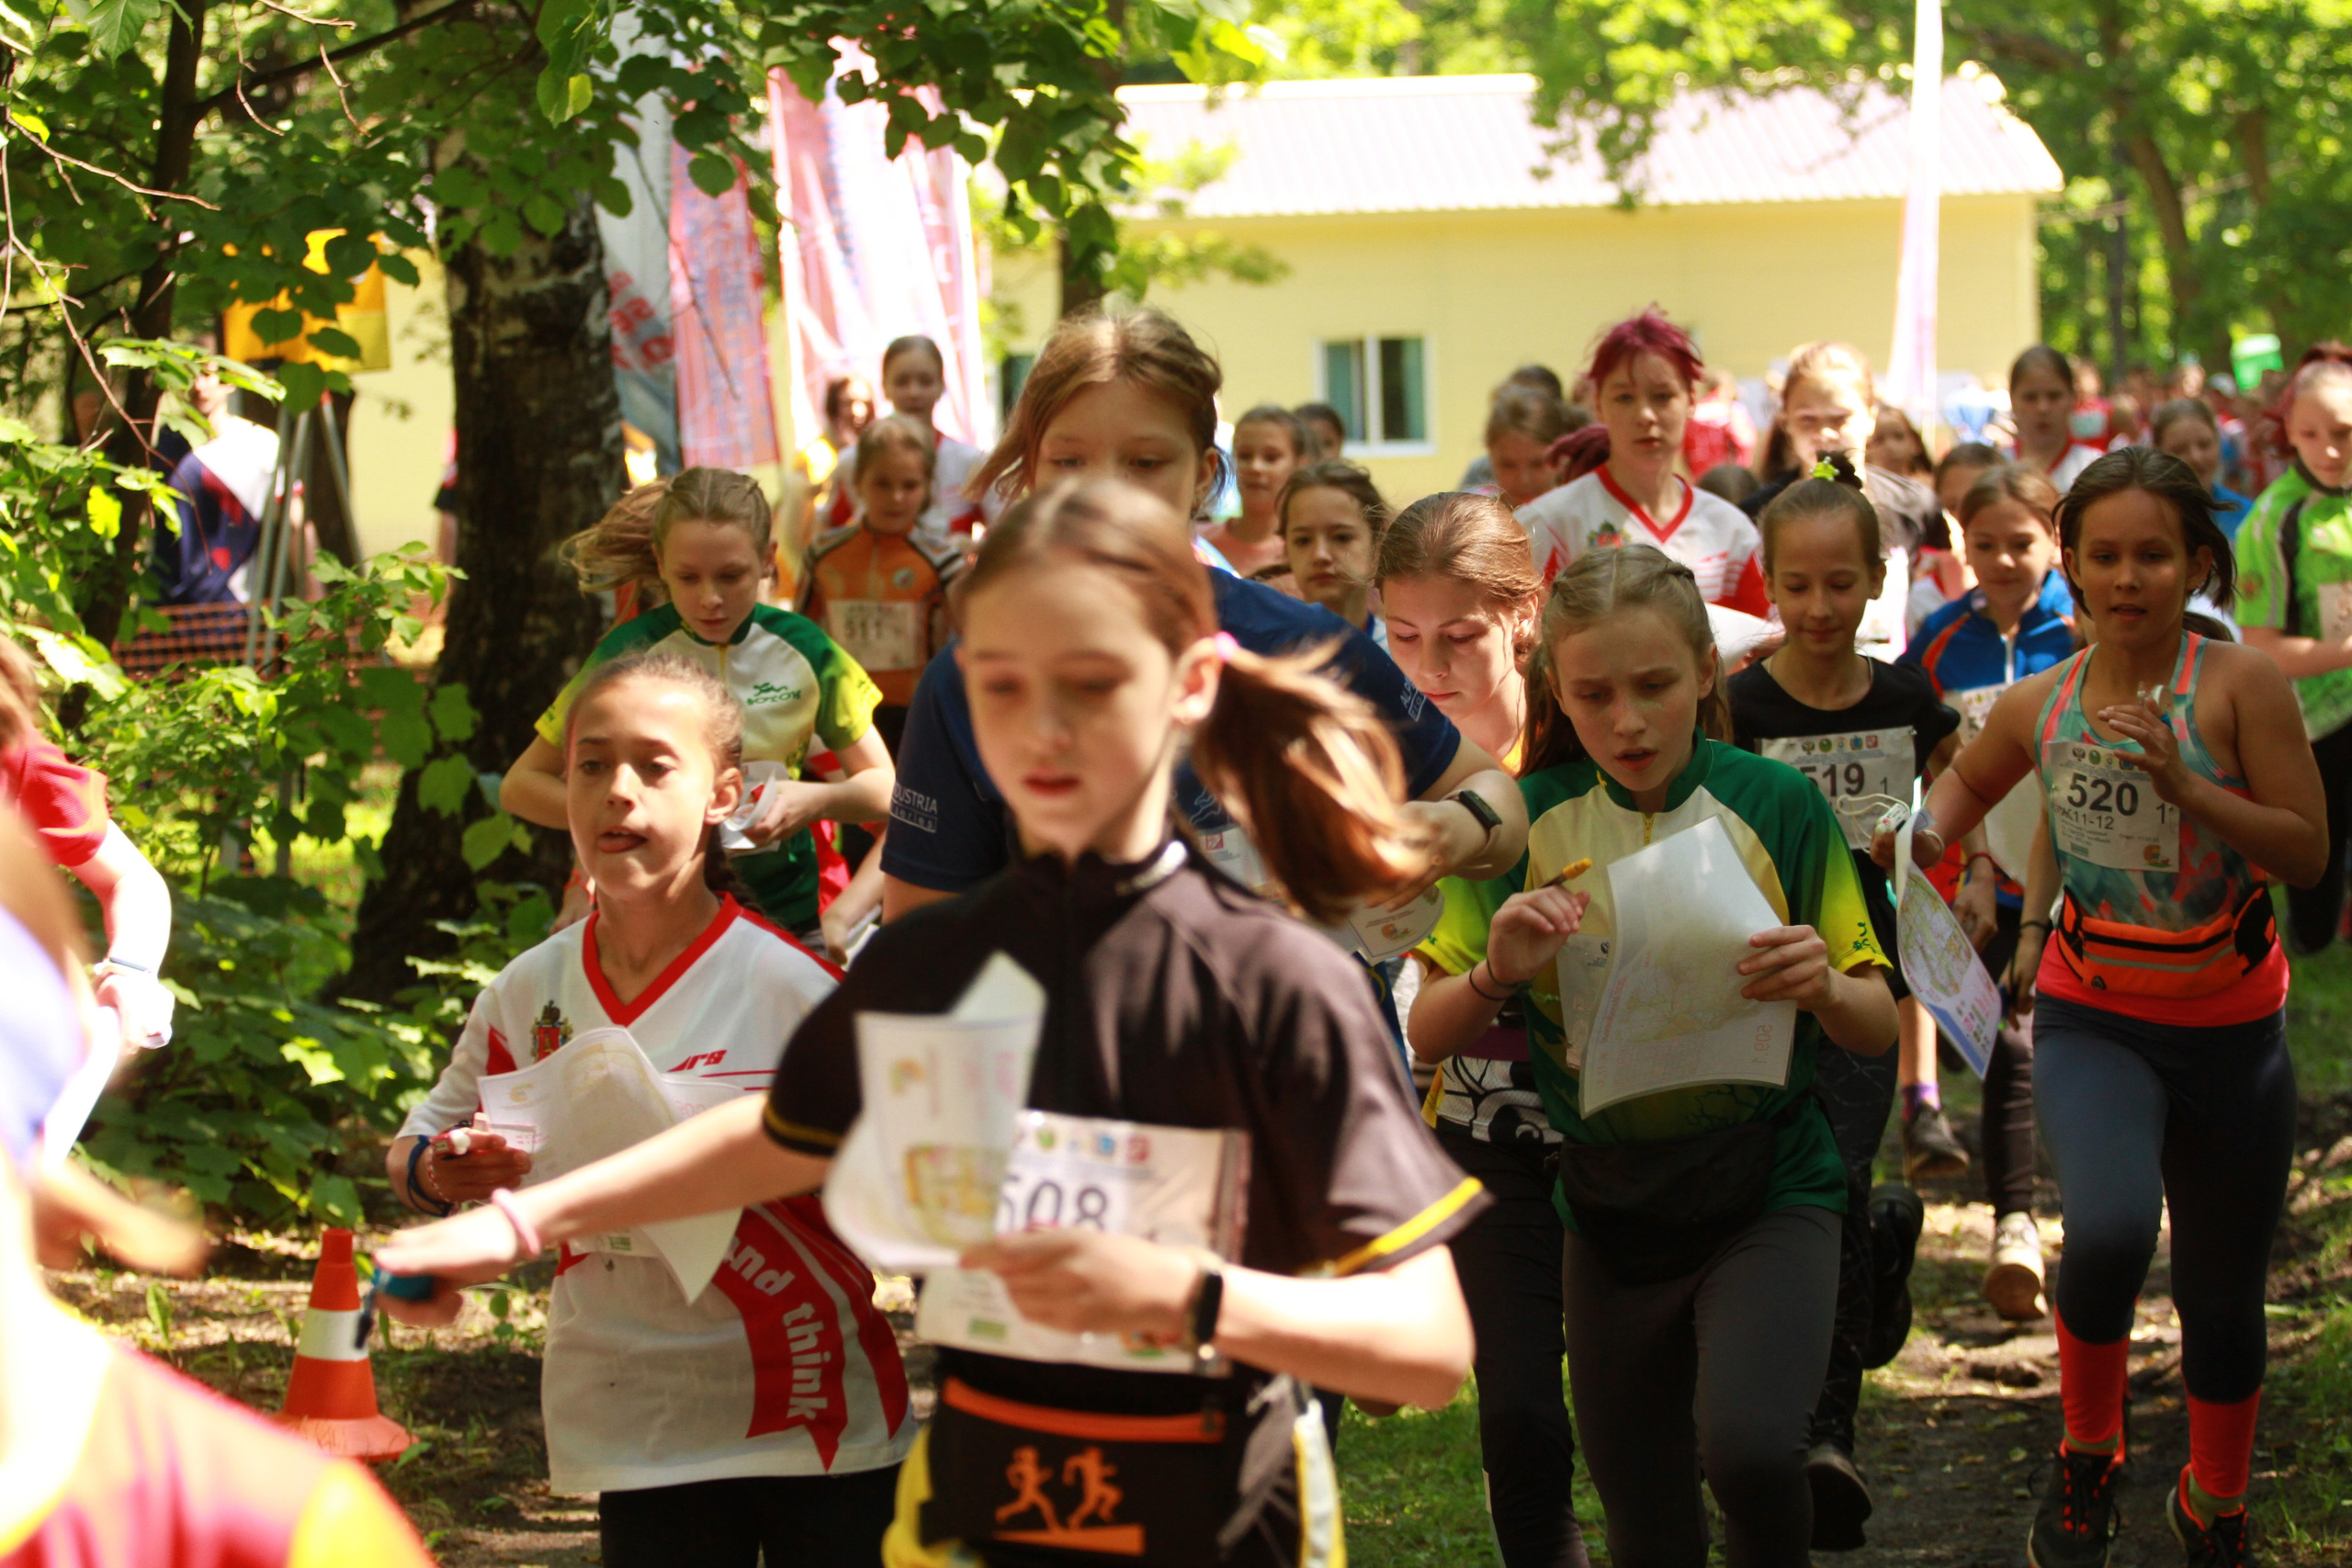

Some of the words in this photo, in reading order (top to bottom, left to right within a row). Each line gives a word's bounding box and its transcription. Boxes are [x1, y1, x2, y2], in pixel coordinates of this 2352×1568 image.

[2067, 772, 2139, 816] 520
[2155, 802, 2165, 825] 1
[782, 1302, 831, 1421] think
